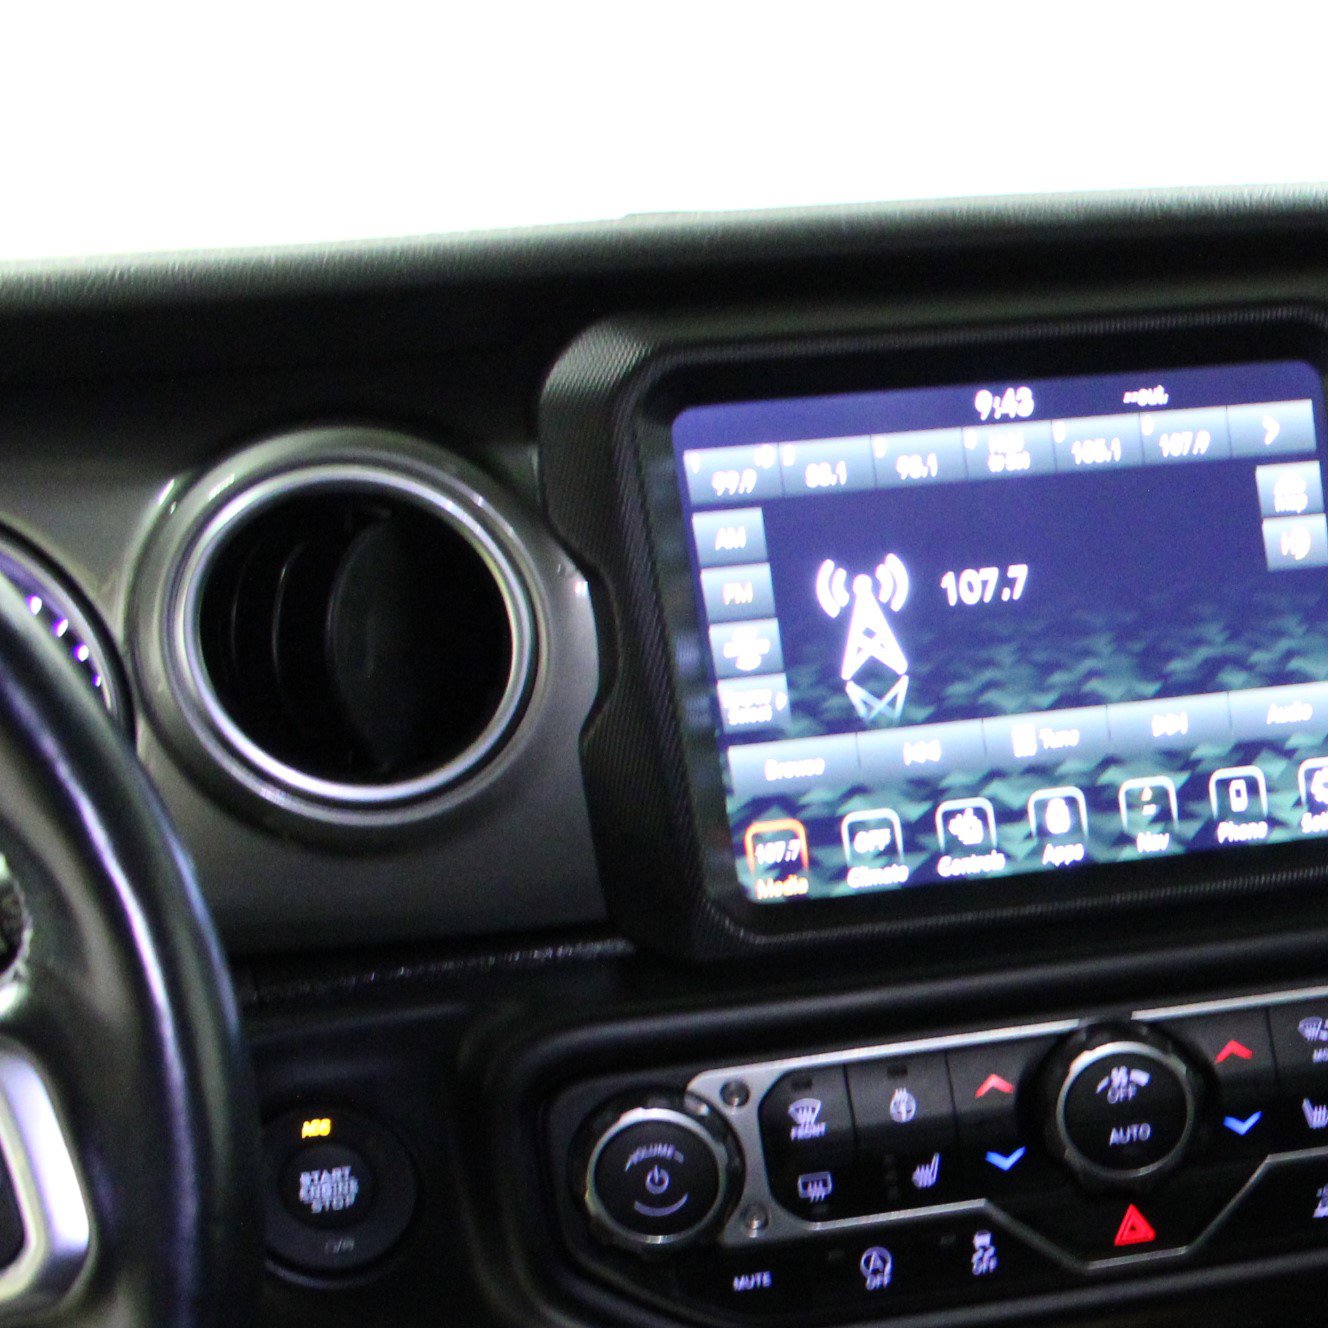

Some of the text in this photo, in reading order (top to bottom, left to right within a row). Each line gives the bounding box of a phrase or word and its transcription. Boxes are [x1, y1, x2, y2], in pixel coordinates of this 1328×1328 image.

[975, 387, 1034, 420] 9:43
[722, 581, 753, 605] FM
[941, 564, 1029, 607] 107.7
[1265, 700, 1313, 725] Audio
[1216, 820, 1269, 844] Phone
[1107, 1083, 1138, 1105] OFF
[1109, 1123, 1152, 1147] AUTO
[733, 1270, 771, 1291] MUTE
[865, 1268, 892, 1291] OFF
